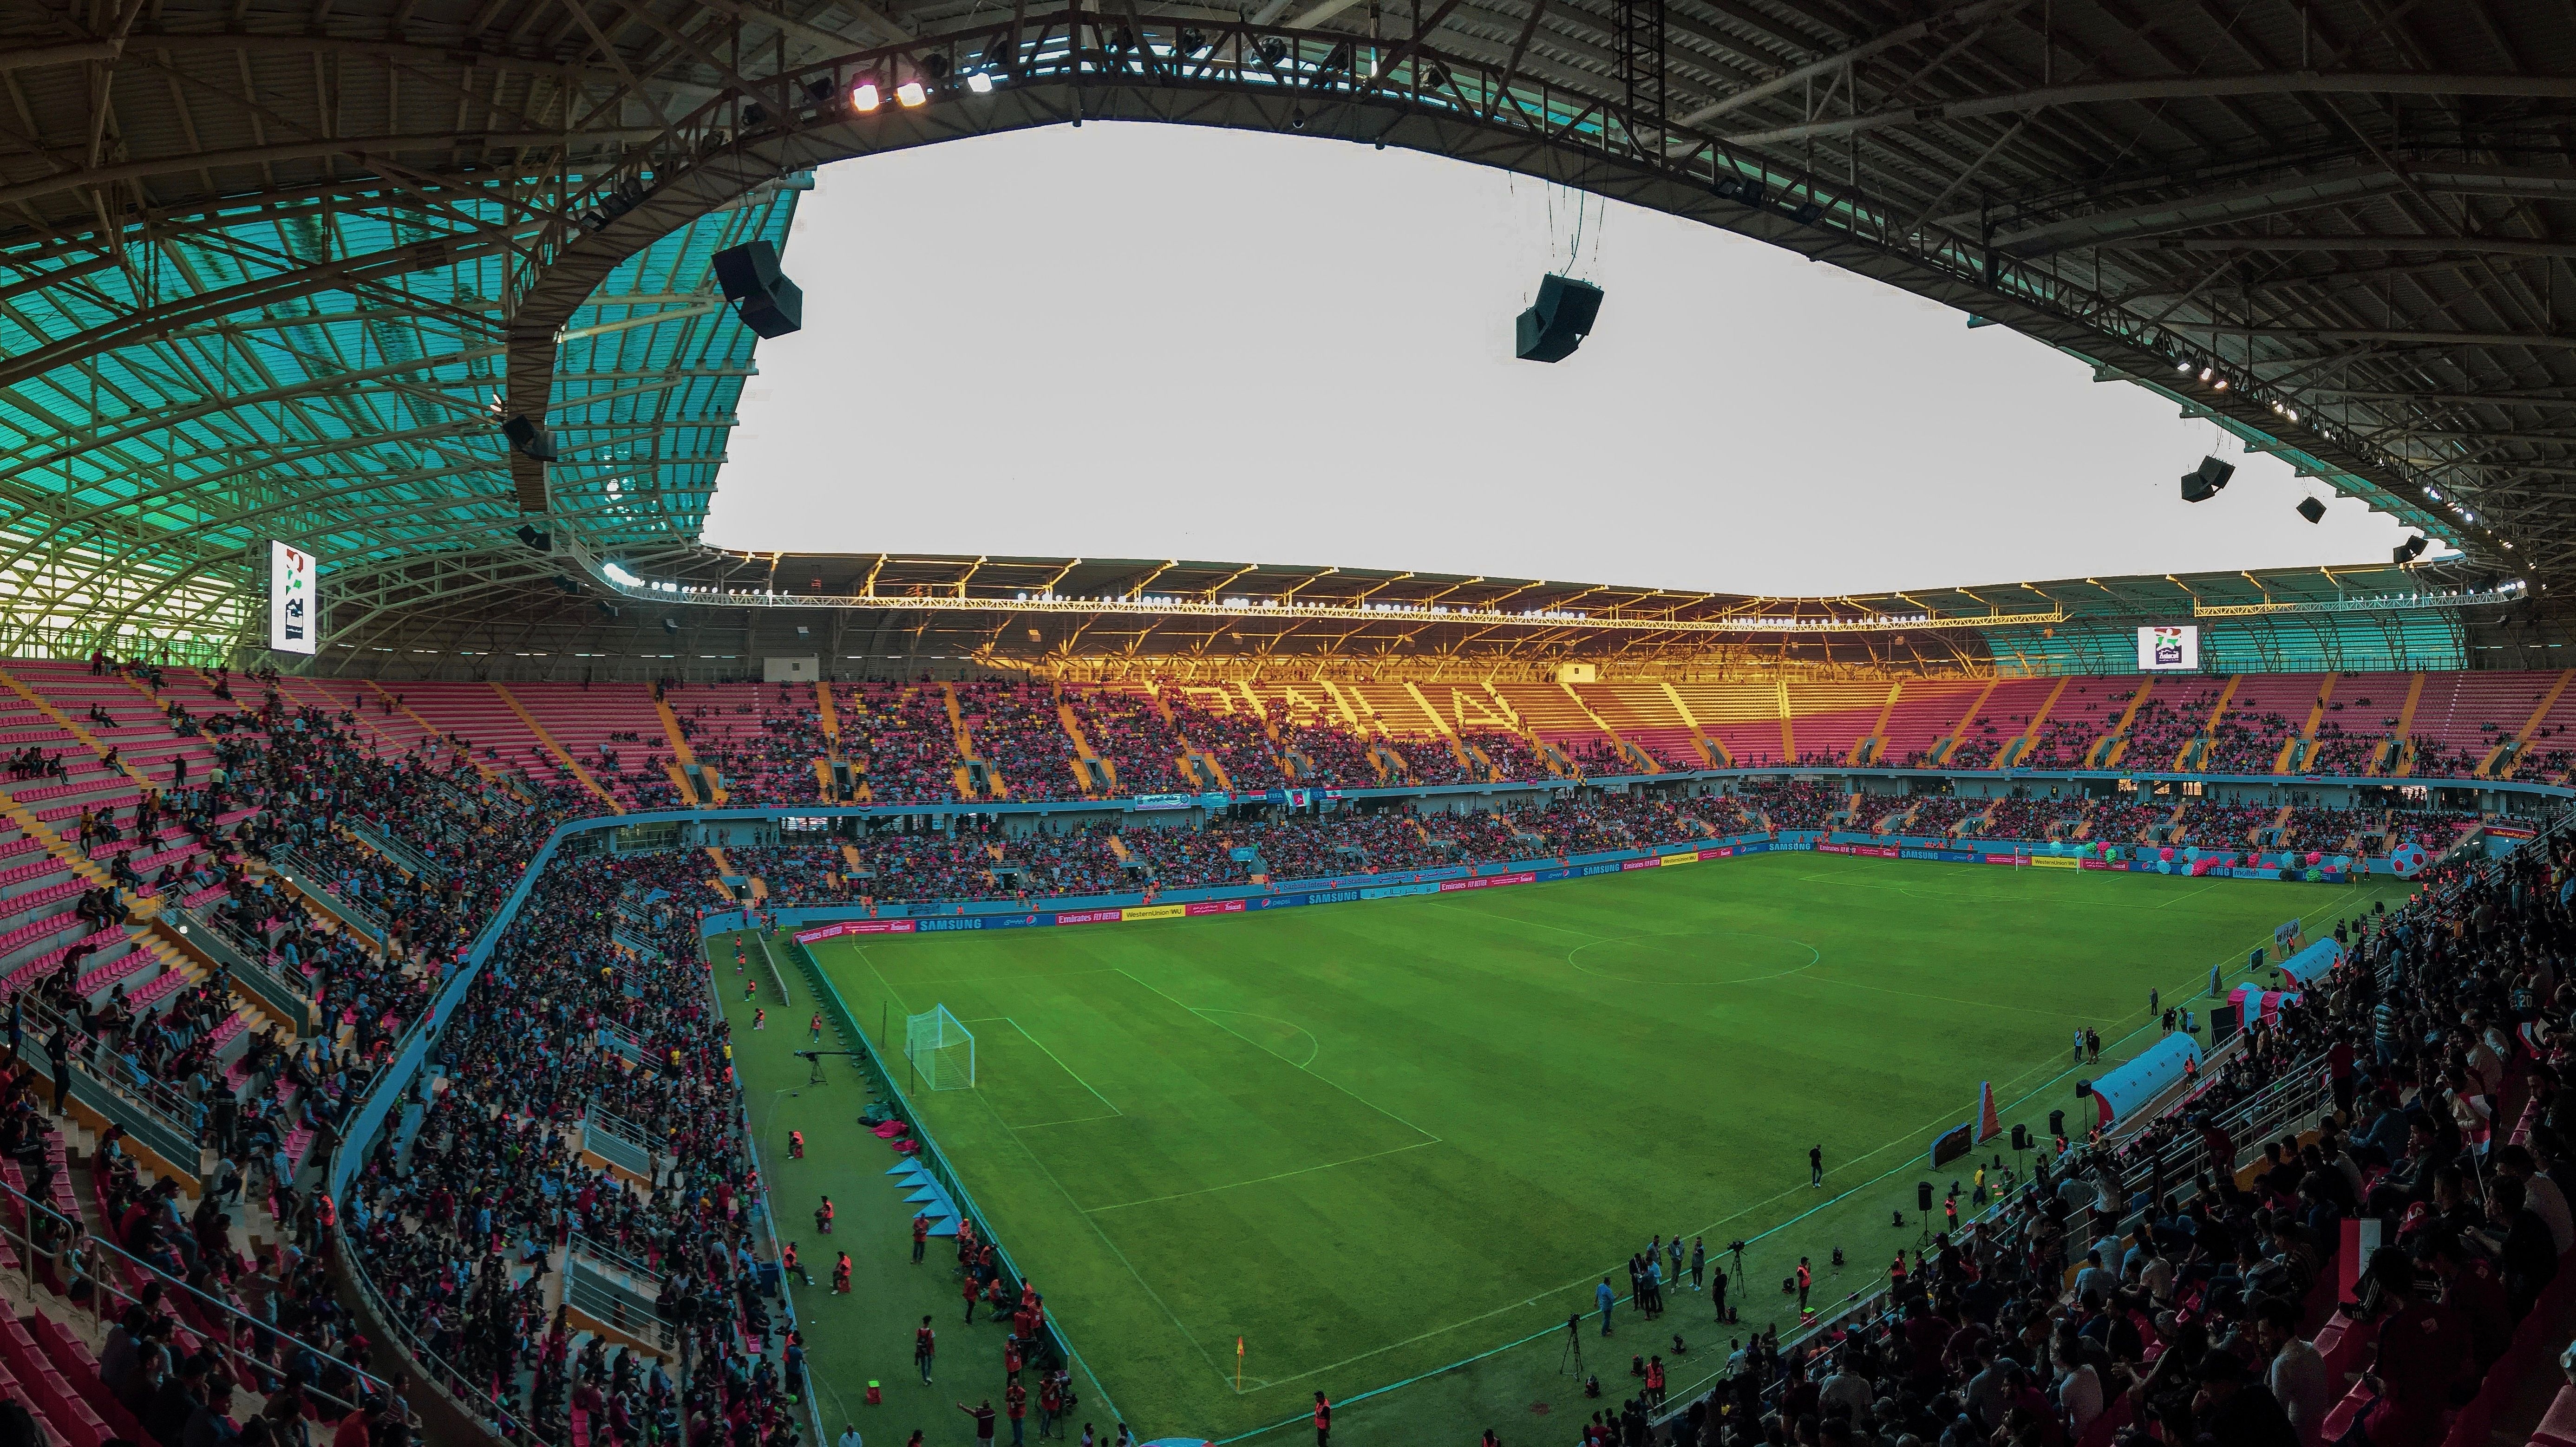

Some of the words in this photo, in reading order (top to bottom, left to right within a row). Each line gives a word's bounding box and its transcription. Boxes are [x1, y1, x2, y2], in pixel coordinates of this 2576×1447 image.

[1901, 851, 1938, 860] SAMSUNG
[1584, 864, 1620, 876] SAMSUNG
[2205, 867, 2229, 876] SUNG
[1475, 879, 1487, 887] BETTER
[1384, 886, 1418, 895] كربلاء
[1309, 891, 1357, 904] SAMSUNG
[1273, 898, 1290, 907] pepsi
[1059, 914, 1092, 924] Emirates
[1102, 912, 1119, 920] BETTER
[1126, 909, 1169, 918] WesternUnion
[920, 919, 981, 931] SAMSUNG
[2519, 995, 2532, 1008] 20
